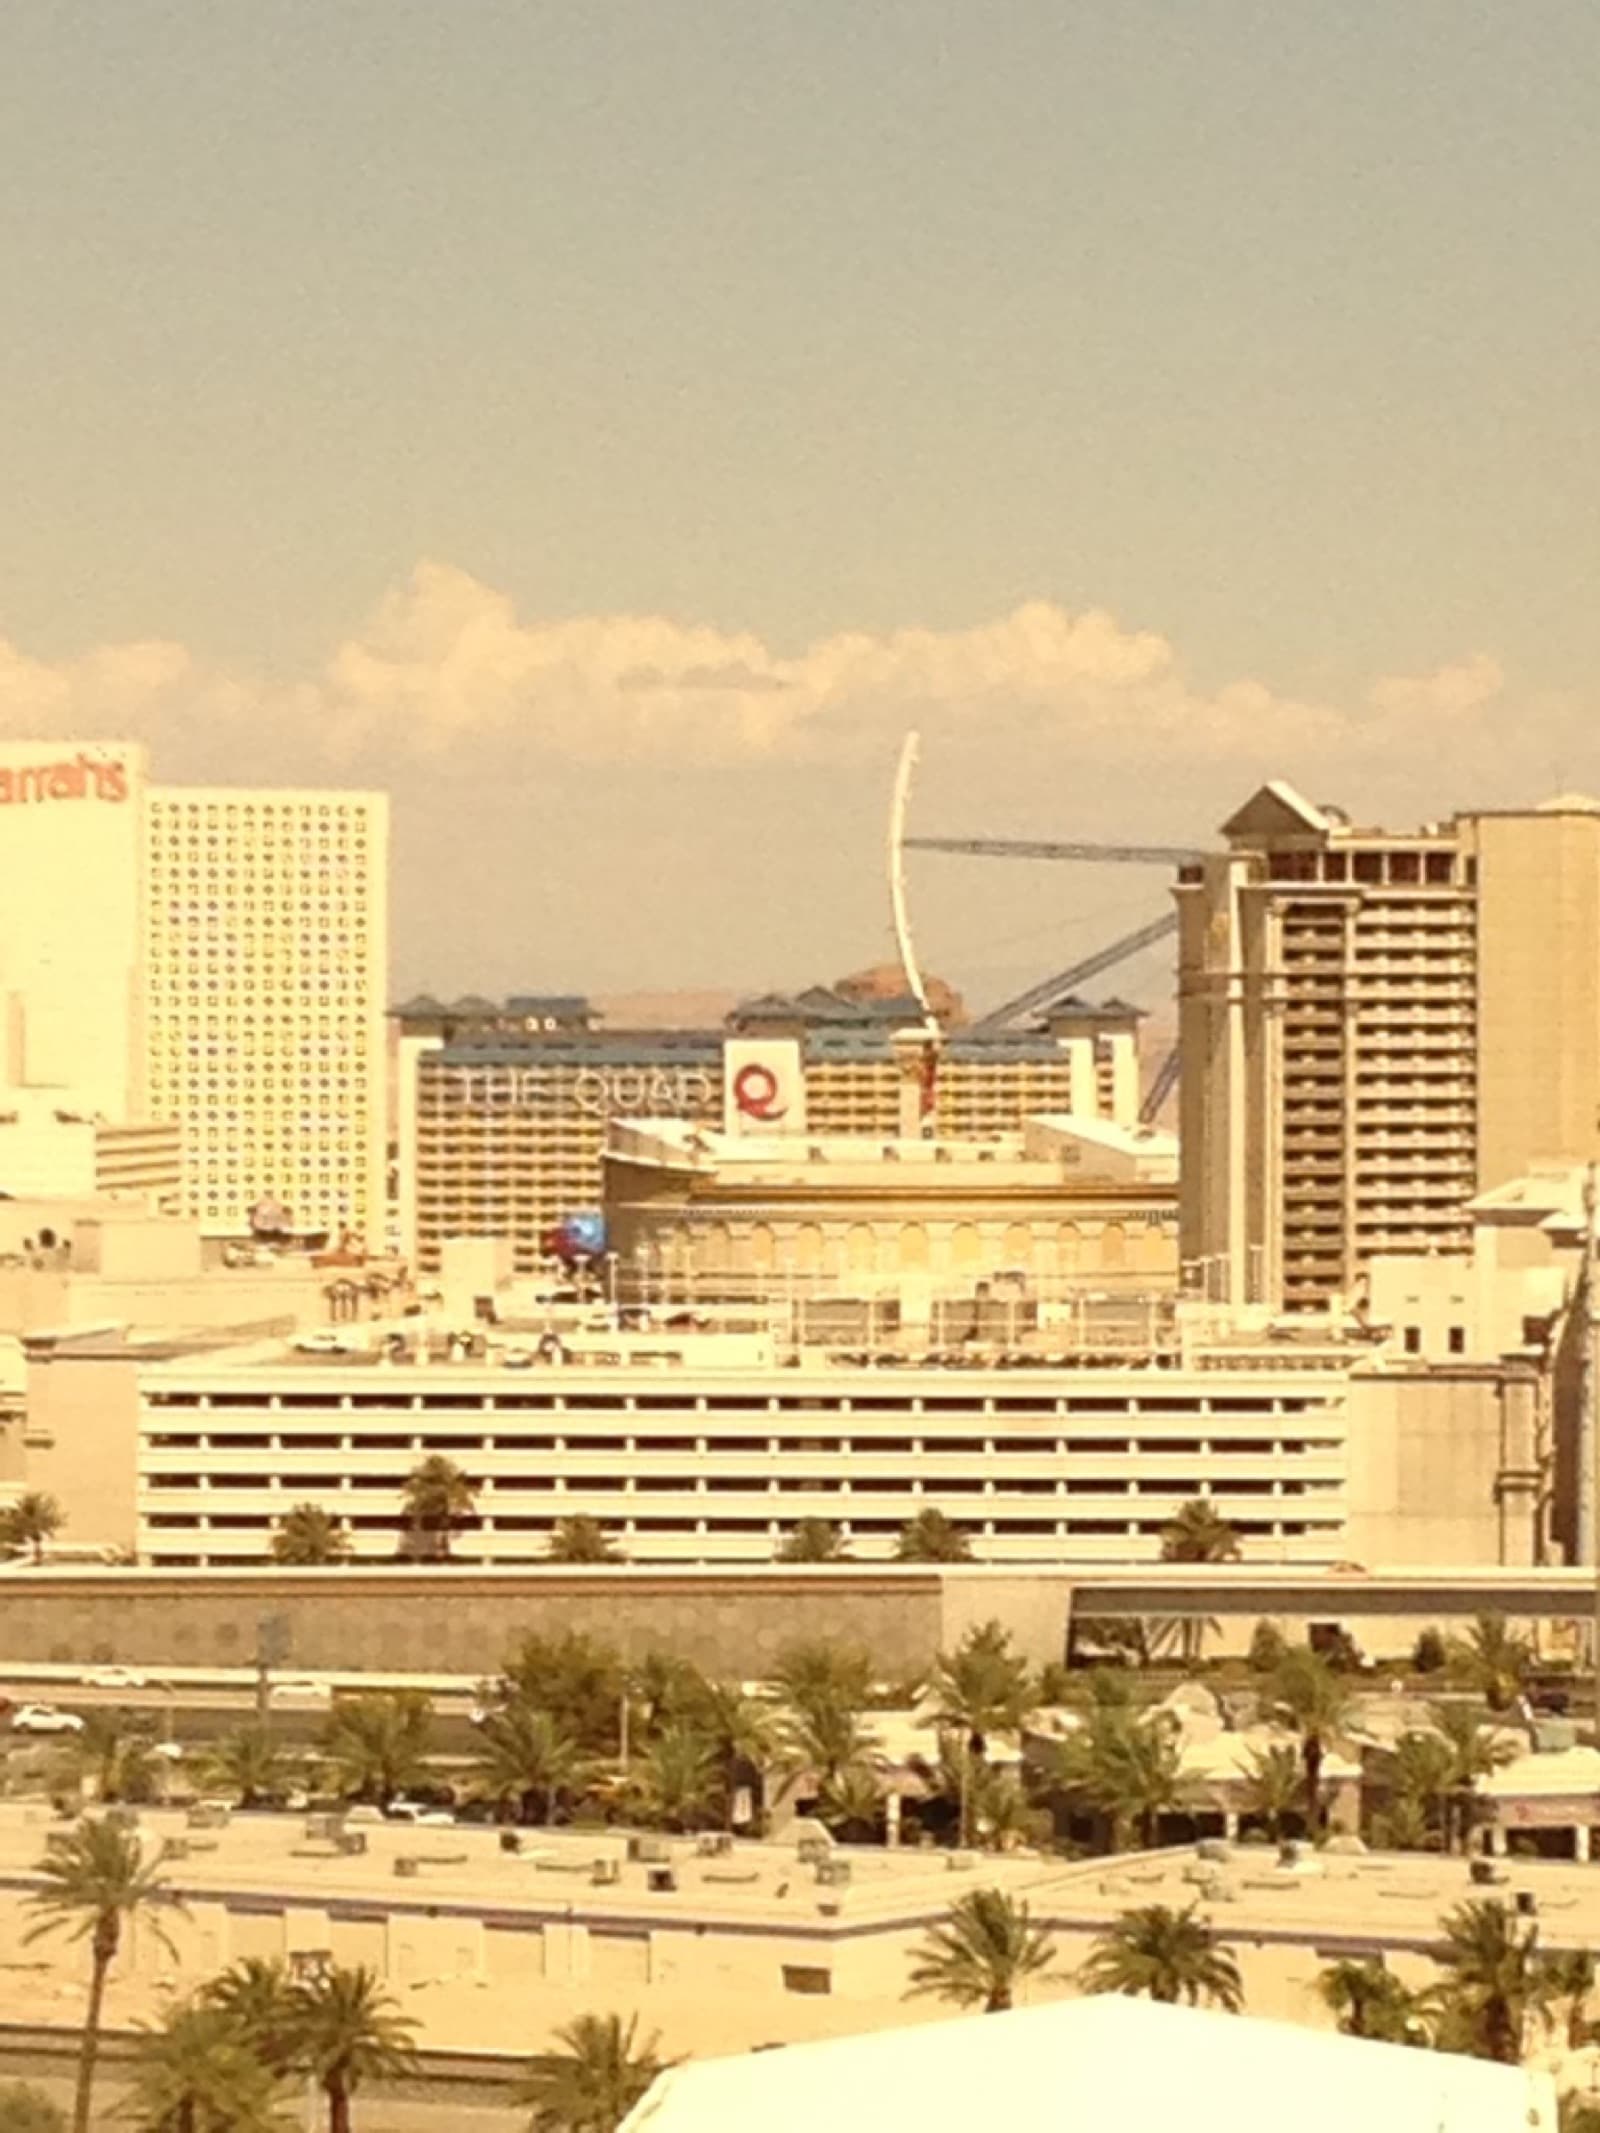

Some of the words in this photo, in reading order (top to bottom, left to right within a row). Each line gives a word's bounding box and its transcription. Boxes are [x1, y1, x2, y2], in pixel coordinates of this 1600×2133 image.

[454, 1067, 549, 1107] THE
[574, 1067, 713, 1115] QUAD
[733, 1064, 790, 1122] Q
